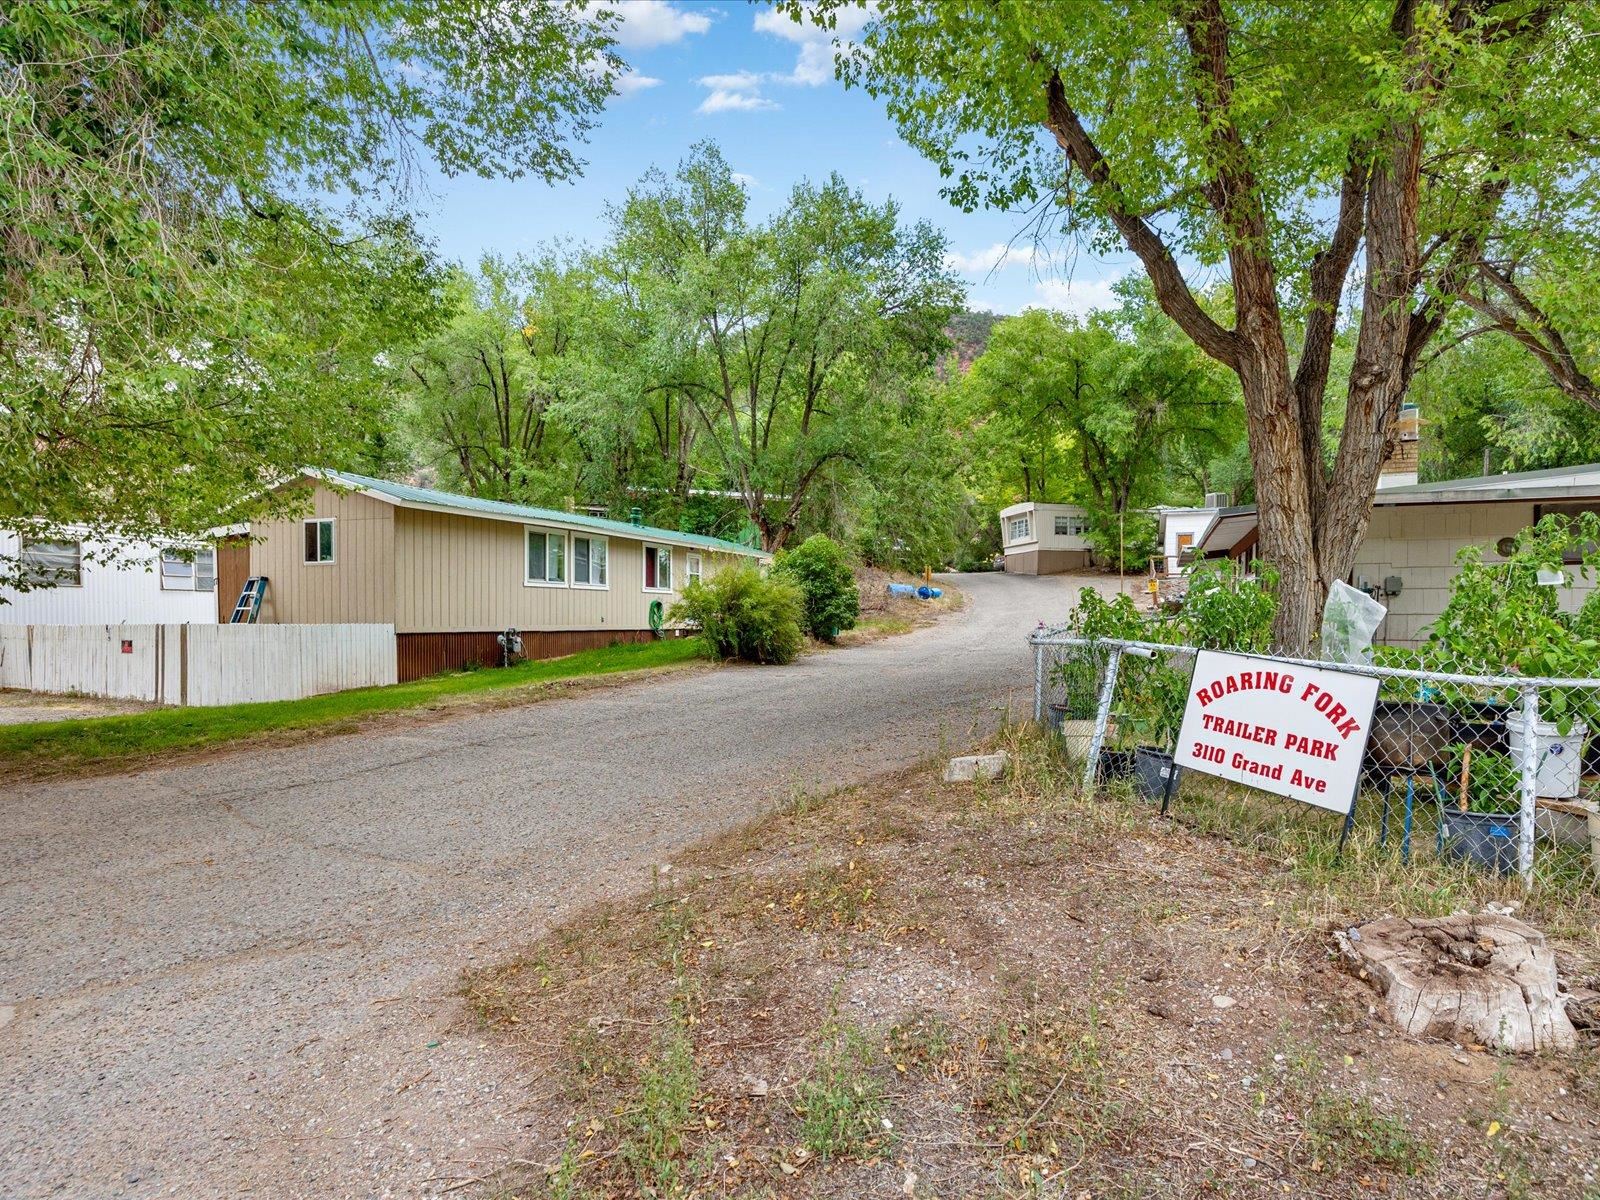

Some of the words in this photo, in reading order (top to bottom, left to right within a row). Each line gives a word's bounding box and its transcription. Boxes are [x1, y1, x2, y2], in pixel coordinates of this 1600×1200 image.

[1195, 671, 1295, 707] ROARING
[1301, 682, 1360, 740] FORK
[1202, 714, 1278, 746] TRAILER
[1284, 733, 1339, 761] PARK
[1192, 742, 1226, 764] 3110
[1231, 753, 1283, 781] Grand
[1290, 769, 1327, 793] Ave
